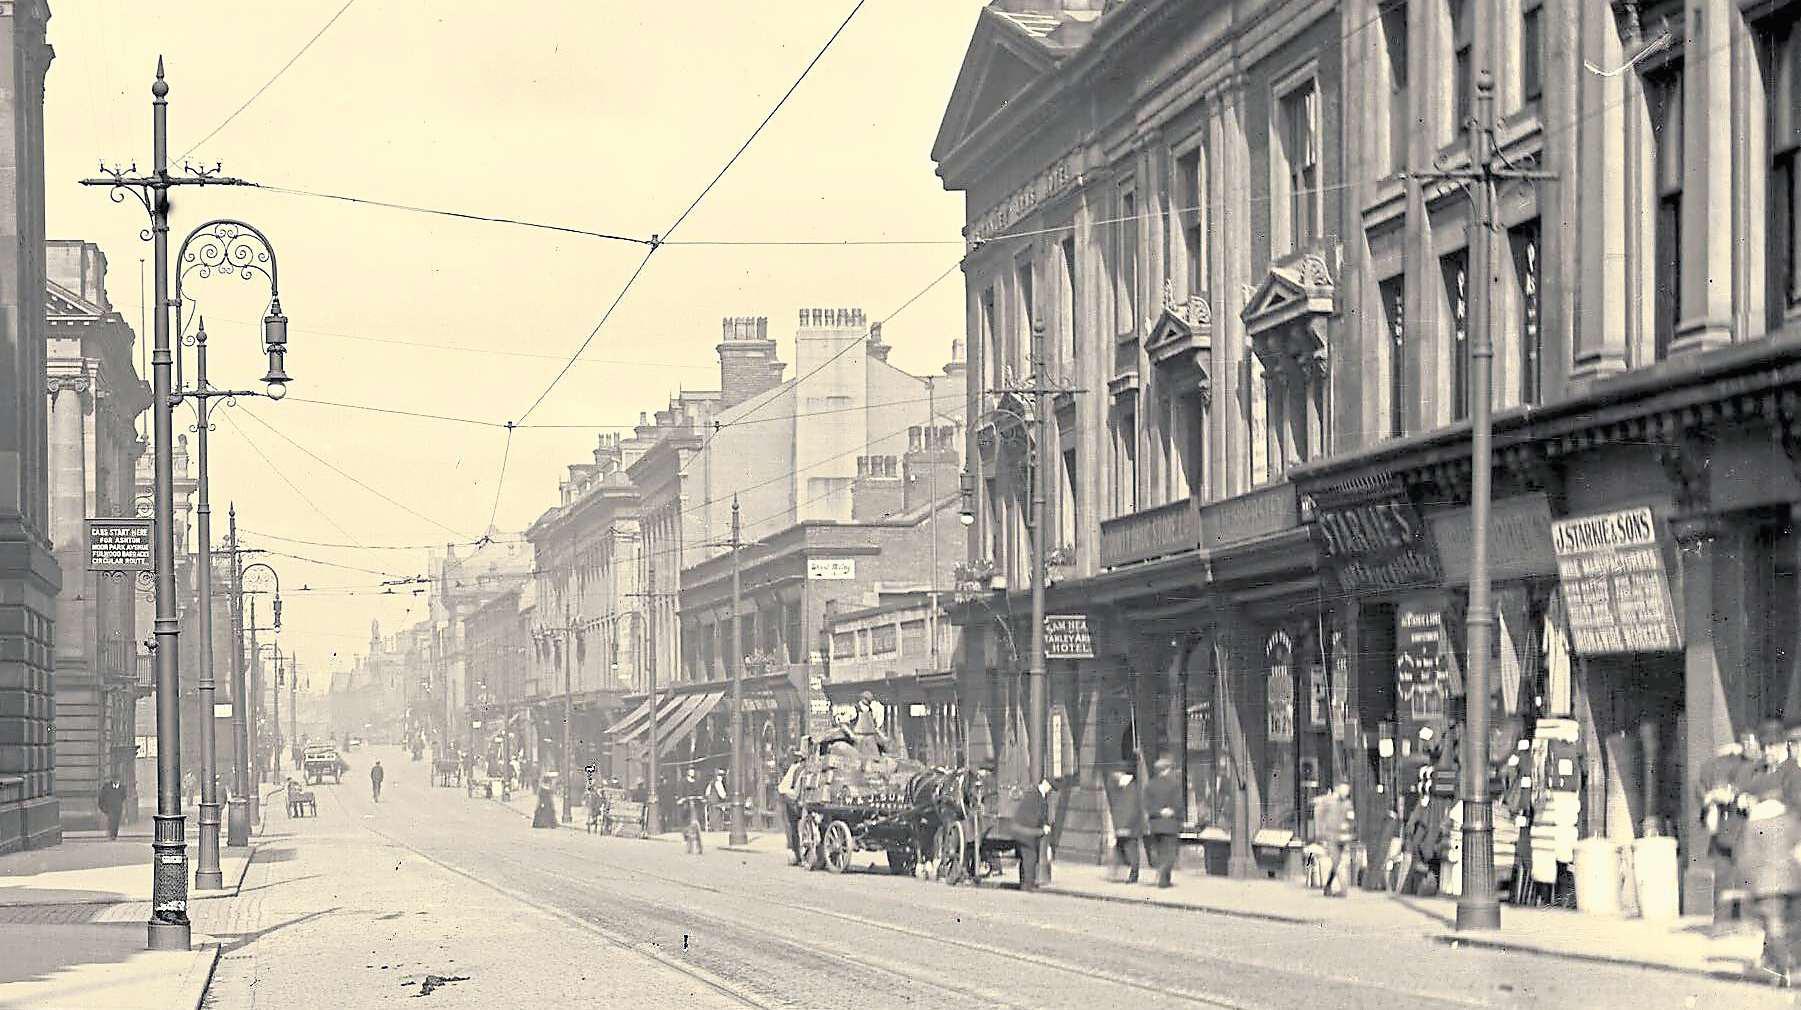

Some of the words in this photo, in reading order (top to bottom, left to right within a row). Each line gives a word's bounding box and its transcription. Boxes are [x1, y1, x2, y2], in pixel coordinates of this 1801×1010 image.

[109, 528, 130, 536] START
[131, 528, 148, 536] HERE
[1565, 517, 1611, 549] STARKIE
[1617, 510, 1651, 544] SONS
[1052, 643, 1089, 653] HOTEL
